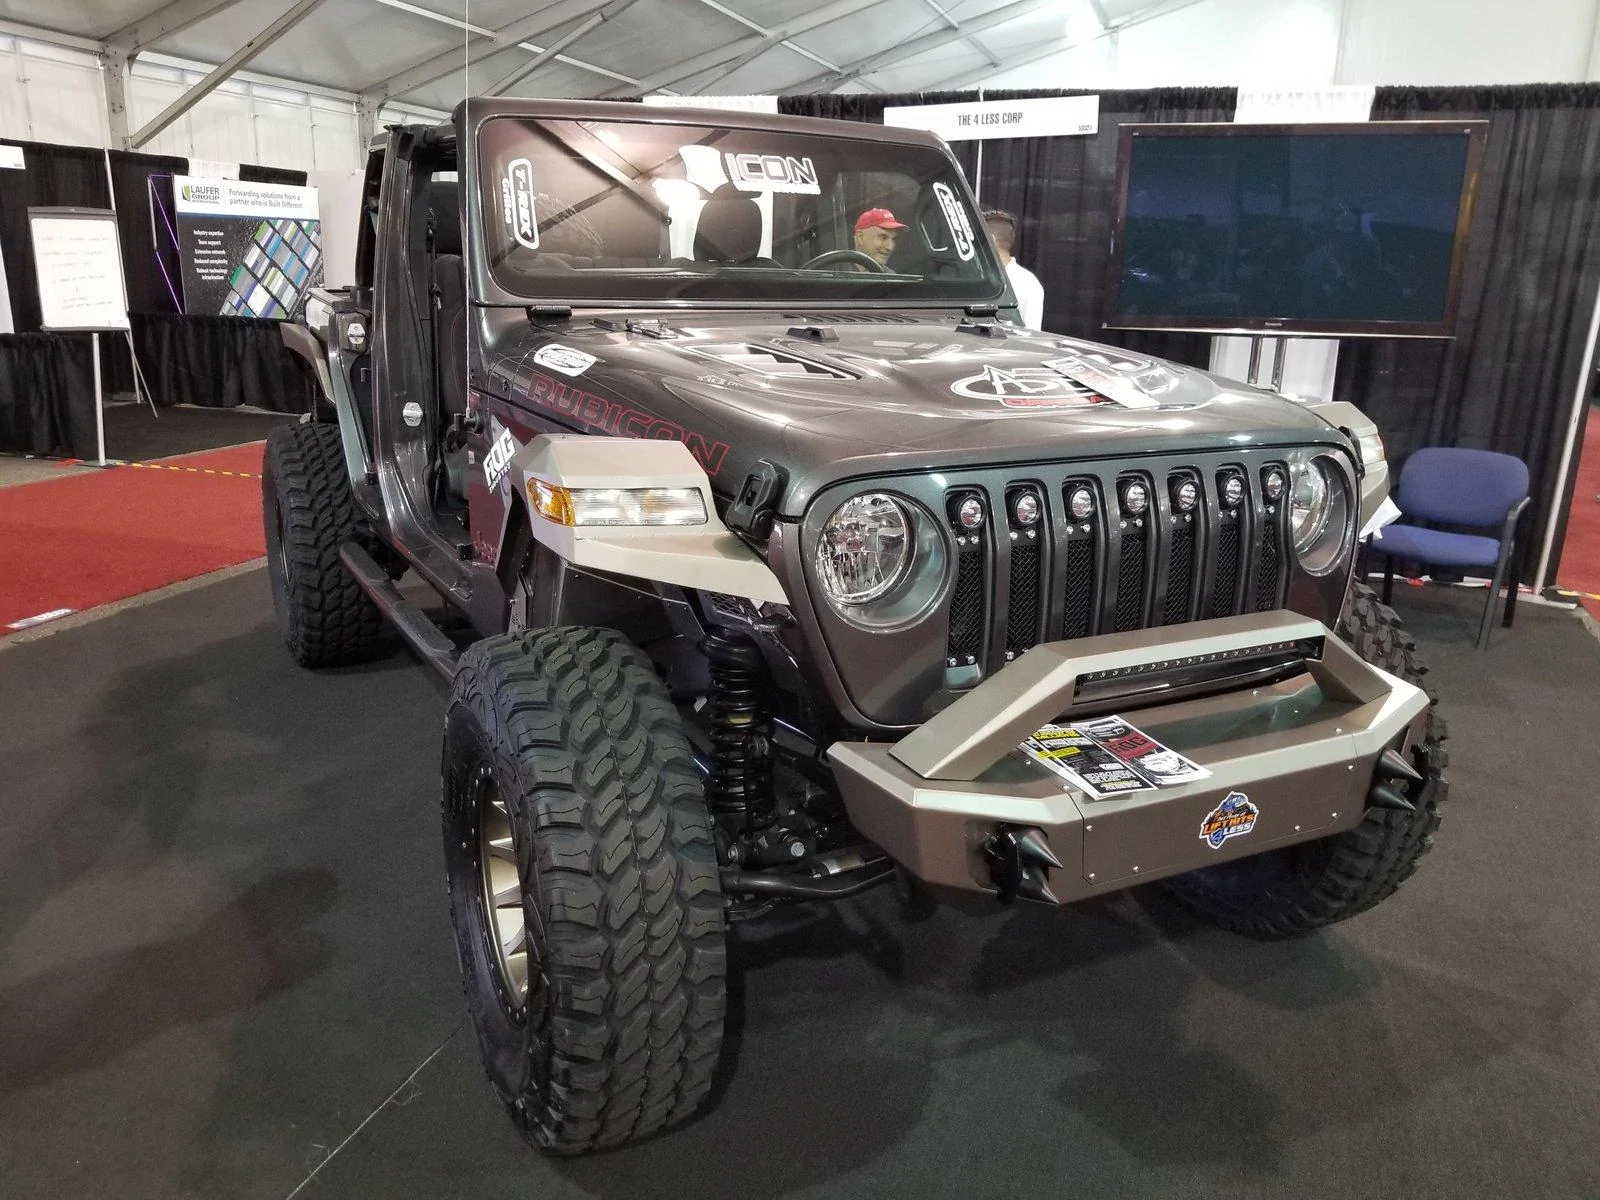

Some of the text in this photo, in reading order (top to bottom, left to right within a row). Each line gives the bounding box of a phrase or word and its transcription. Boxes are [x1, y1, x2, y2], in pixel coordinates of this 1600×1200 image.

[957, 112, 1023, 126] THE 4 LESS CORP
[724, 153, 819, 185] ICON
[190, 185, 220, 195] LAUFER
[228, 188, 260, 199] Forwarding
[260, 192, 284, 200] solutions
[191, 193, 220, 201] GROUP
[229, 198, 250, 206] partner
[268, 200, 281, 208] Built
[281, 201, 303, 209] Different
[515, 168, 533, 238] T-REX
[525, 373, 731, 476] RUBICON
